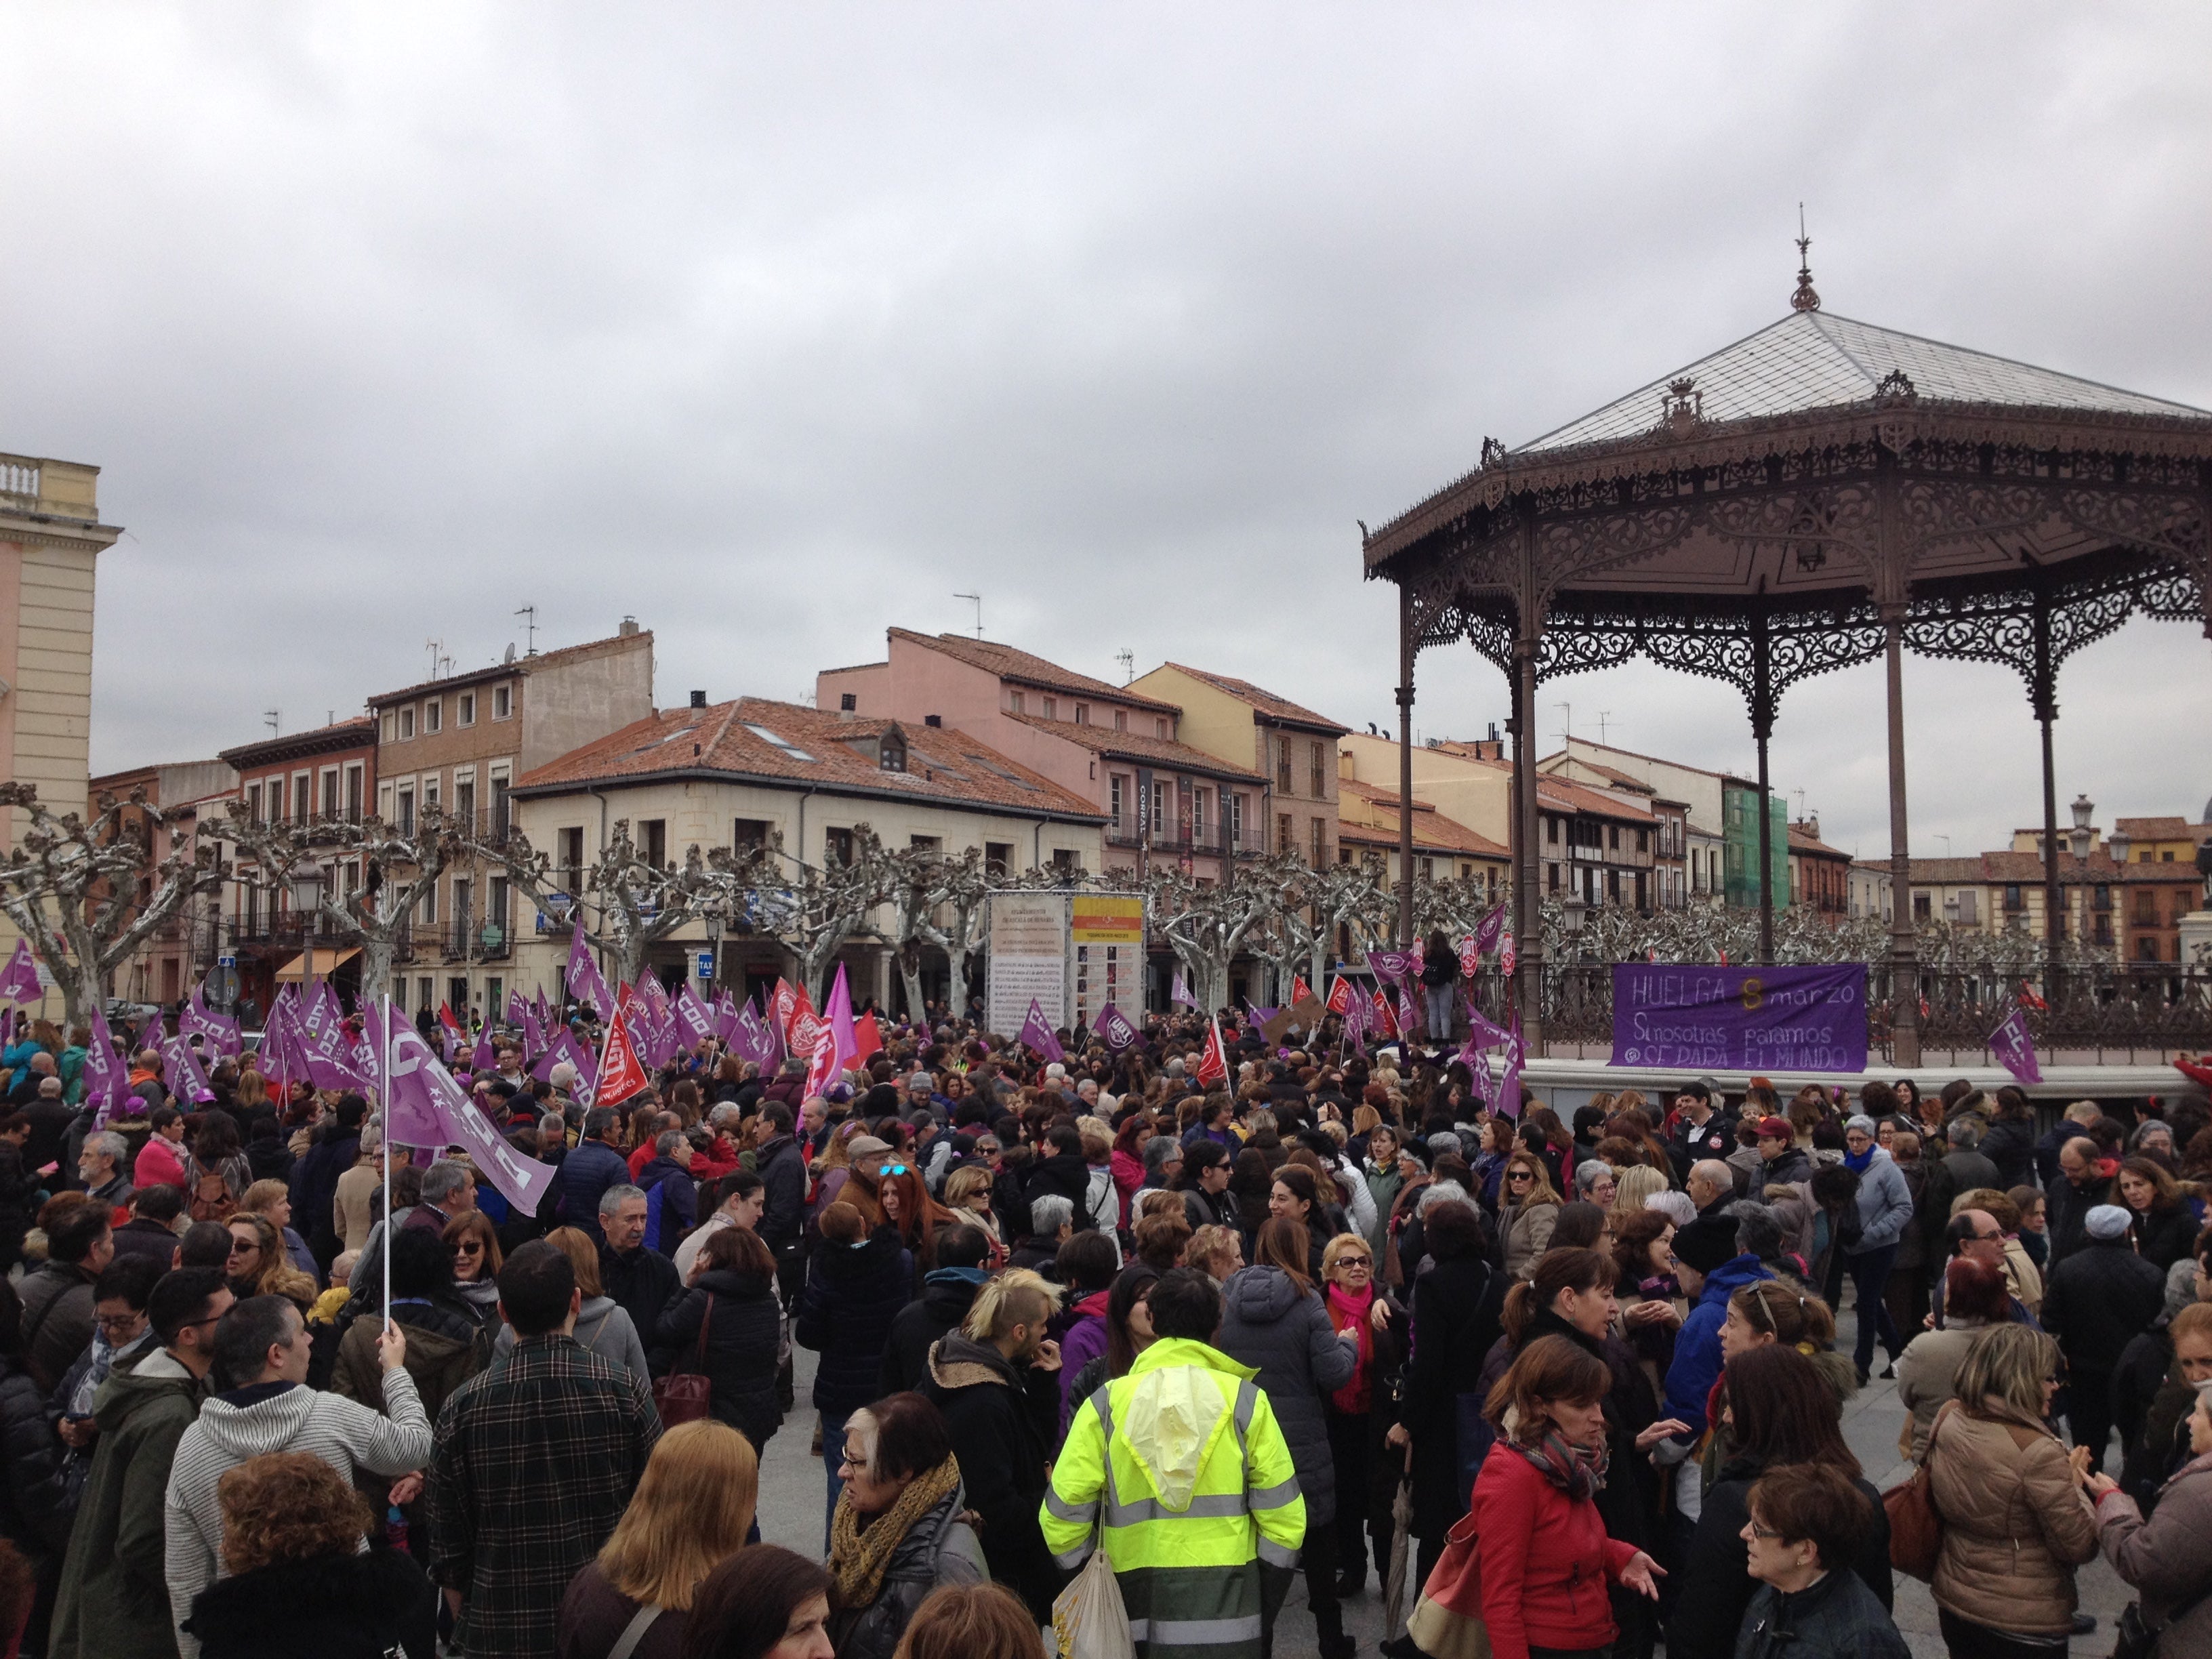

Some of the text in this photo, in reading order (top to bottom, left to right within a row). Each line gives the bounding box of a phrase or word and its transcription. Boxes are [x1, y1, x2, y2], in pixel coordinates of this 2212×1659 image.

[1463, 941, 1475, 956] UGT
[1633, 975, 1854, 1010] HUELGA 8 marzo
[1110, 1018, 1133, 1040] UGT
[1654, 1025, 1727, 1044] nosotras
[1744, 1026, 1832, 1047] paramos
[1641, 1045, 1672, 1065] SE
[1674, 1046, 1728, 1066] PARA
[1774, 1046, 1847, 1069] MUNDO
